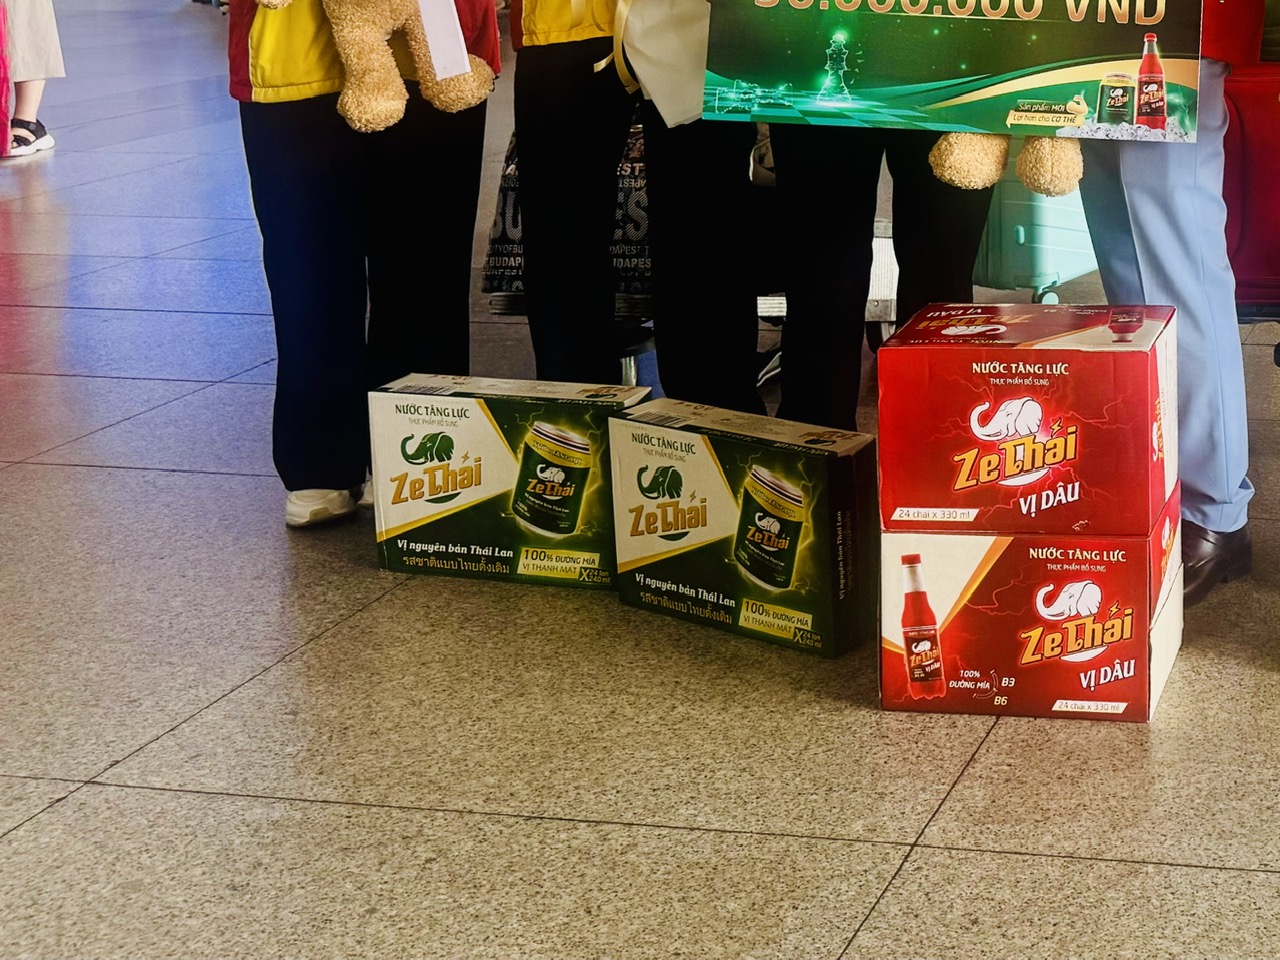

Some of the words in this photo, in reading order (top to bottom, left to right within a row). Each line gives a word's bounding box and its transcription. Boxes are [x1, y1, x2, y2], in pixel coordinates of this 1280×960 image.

[972, 360, 1008, 374] NƯỚC
[1010, 361, 1043, 375] TĂNG
[1046, 361, 1069, 377] LỰC
[1033, 378, 1049, 387] SUNG
[395, 402, 423, 416] NƯỚC
[424, 404, 450, 418] TĂNG
[452, 407, 470, 420] LỰC
[631, 431, 656, 447] NƯỚC
[656, 437, 679, 451] TĂNG
[680, 442, 696, 455] LỰC
[1019, 493, 1036, 518] VỊ
[1040, 481, 1080, 511] DÂU
[898, 509, 911, 519] 24
[912, 509, 930, 519] chai
[940, 510, 957, 519] 330
[959, 510, 970, 519] ml
[397, 539, 407, 552] Vị
[409, 542, 446, 554] nguyên
[447, 543, 468, 555] bản
[470, 545, 492, 556] Thái
[494, 547, 514, 558] Lan
[1029, 546, 1065, 559] NƯỚC
[1067, 548, 1100, 561] TĂNG
[1103, 549, 1127, 564] LỰC
[524, 548, 554, 563] 100%
[554, 553, 581, 564] ĐƯỜNG
[582, 553, 596, 566] MÍA
[531, 564, 557, 574] THANH
[959, 669, 981, 678] 100%
[1079, 669, 1097, 692] VỊ
[1100, 658, 1136, 685] DÂU
[949, 679, 976, 690] ĐƯỜNG
[976, 678, 991, 690] MÍA
[1001, 677, 1016, 688] B3
[993, 696, 1009, 706] B6
[1058, 701, 1069, 710] 24
[1093, 702, 1109, 711] 330
